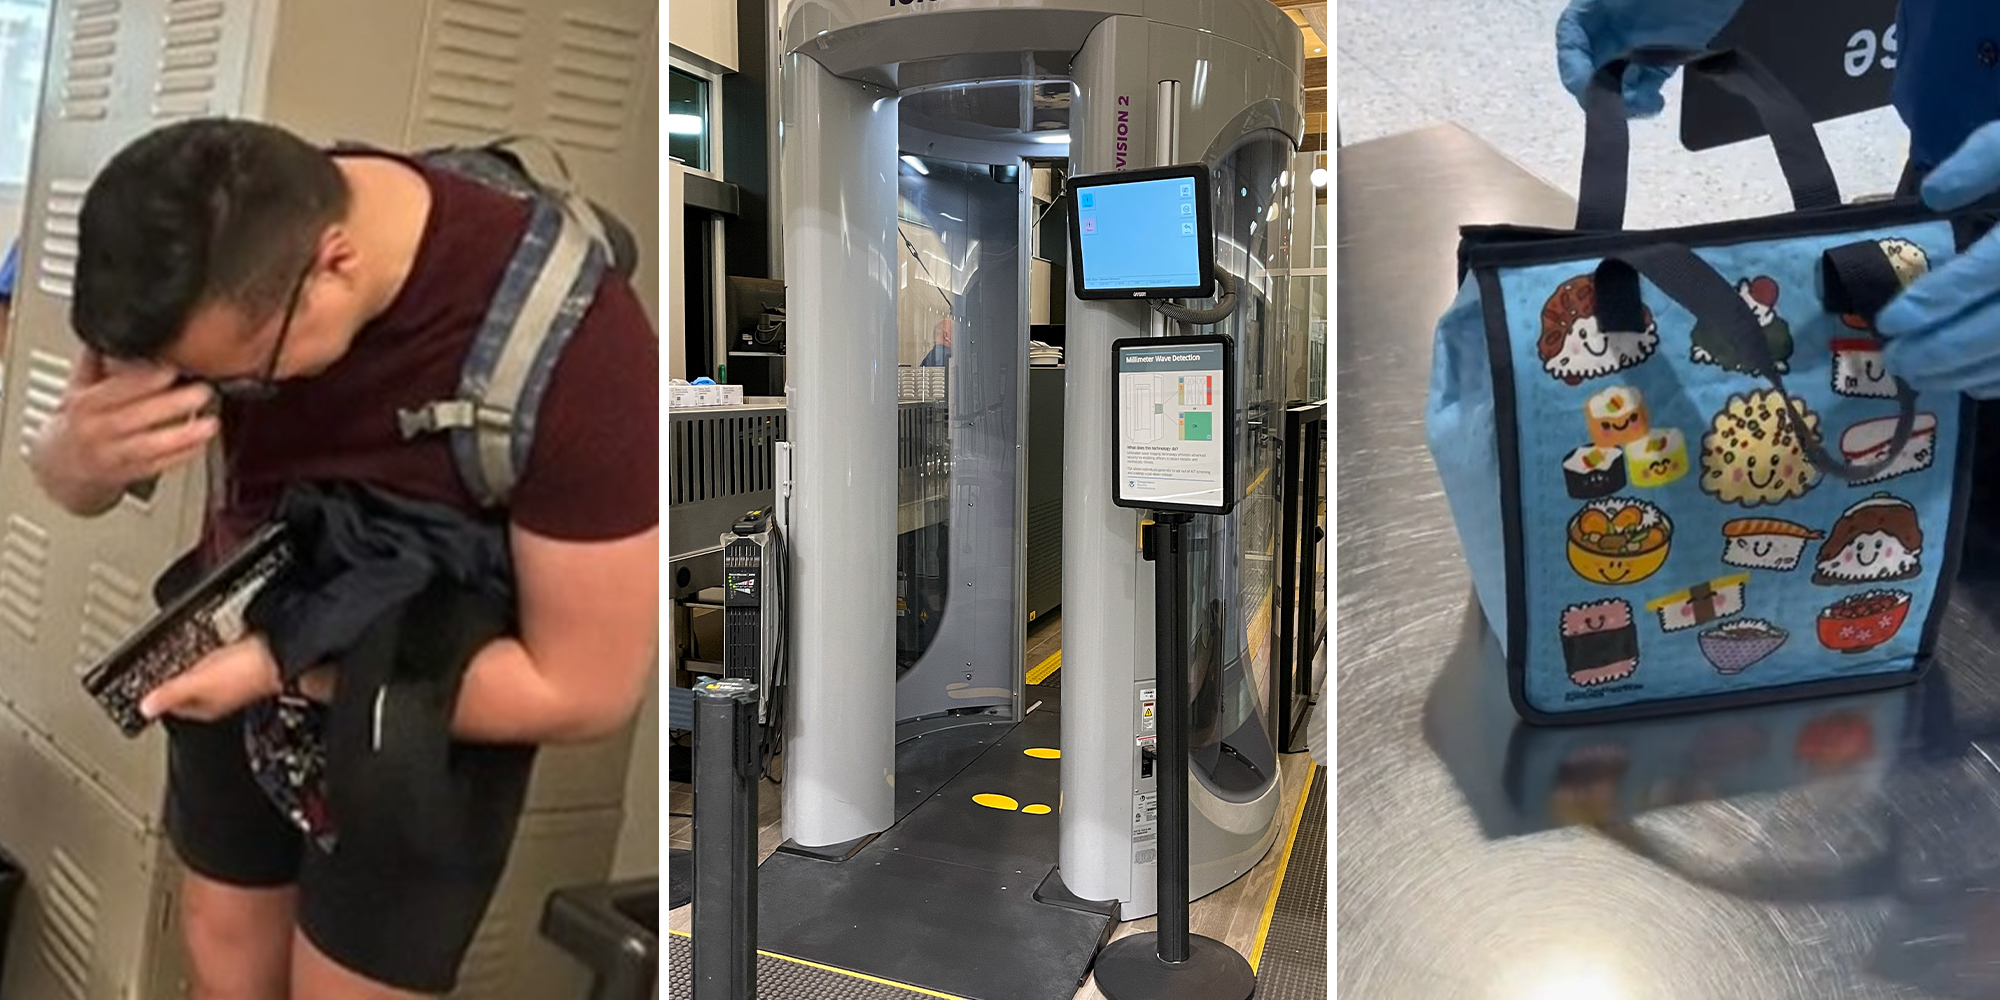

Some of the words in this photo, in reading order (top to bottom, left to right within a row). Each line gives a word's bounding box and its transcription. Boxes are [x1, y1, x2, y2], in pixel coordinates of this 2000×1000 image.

[1118, 95, 1129, 106] 2
[1116, 110, 1129, 172] VISION
[1172, 354, 1200, 362] Detection
